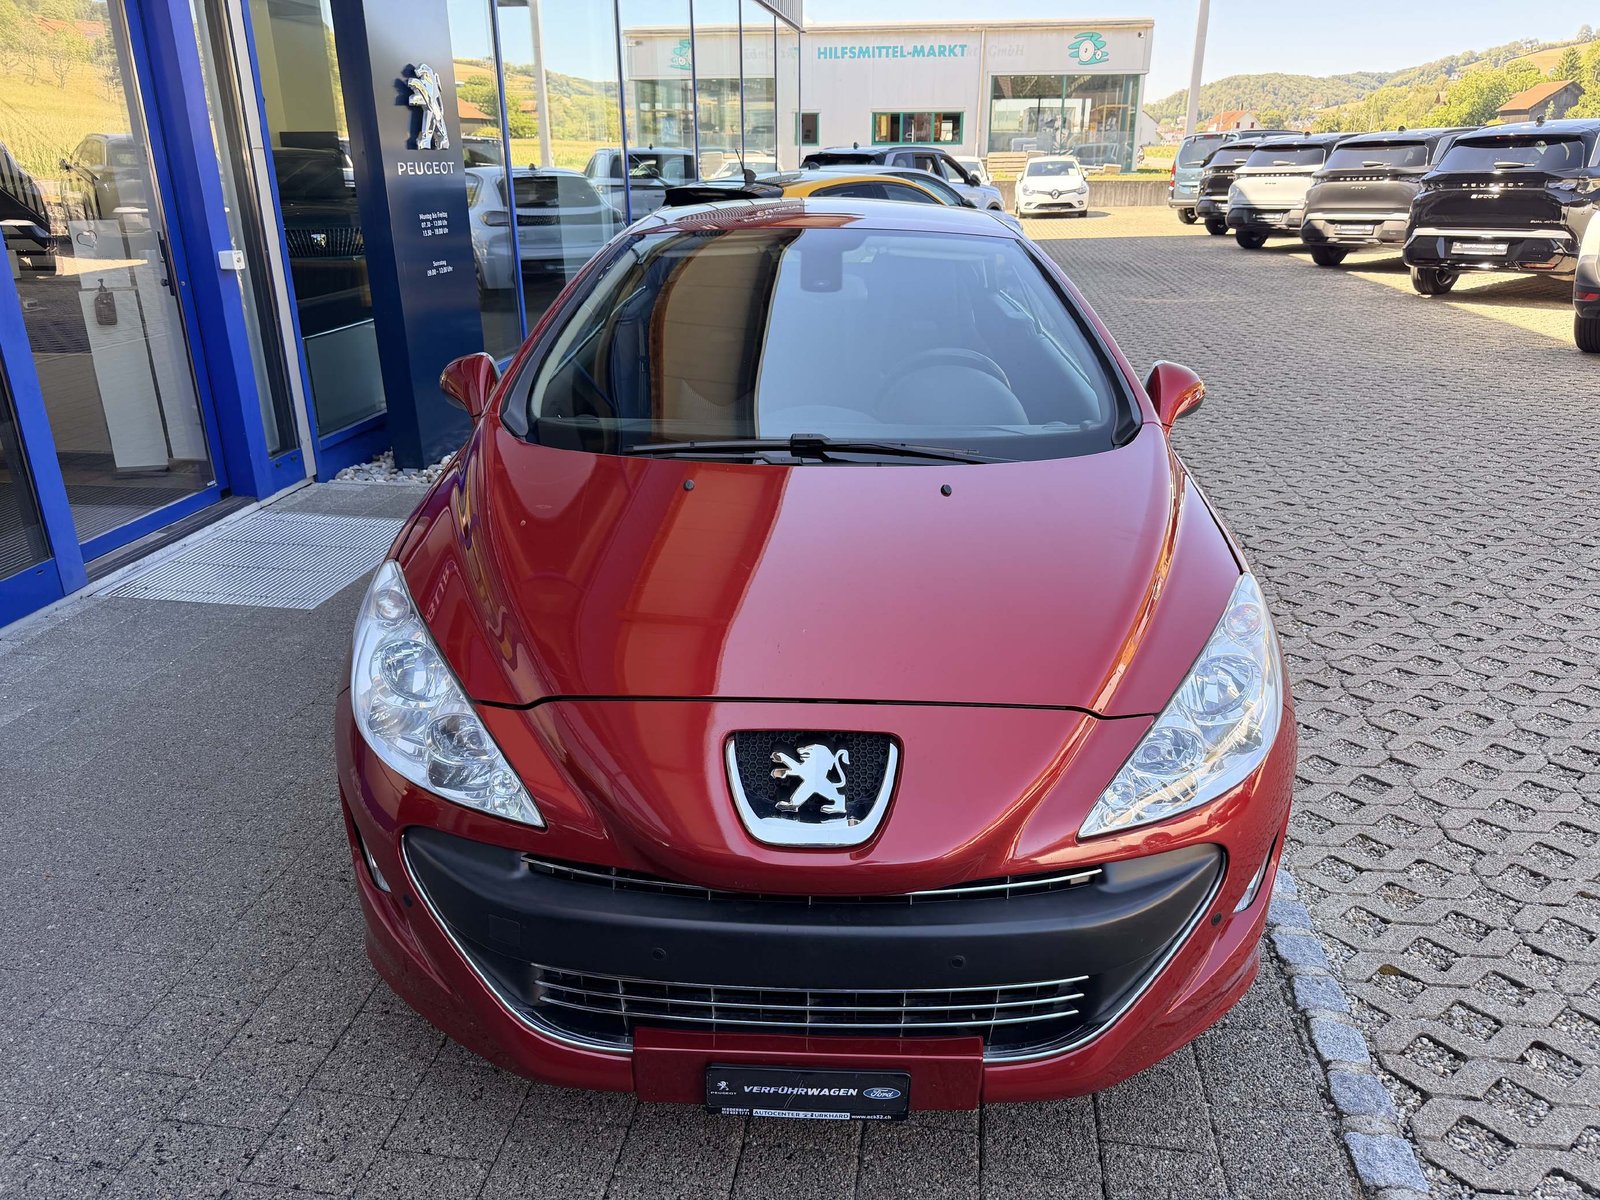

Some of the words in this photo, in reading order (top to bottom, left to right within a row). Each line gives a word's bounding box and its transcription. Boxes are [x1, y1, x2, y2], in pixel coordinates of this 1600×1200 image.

[817, 44, 967, 60] HILFSMITTEL-MARKT
[397, 161, 455, 176] PEUGEOT
[743, 1085, 858, 1096] VERFÜHRWAGEN
[870, 1089, 893, 1098] Ford
[753, 1110, 800, 1118] AUTOCENTER
